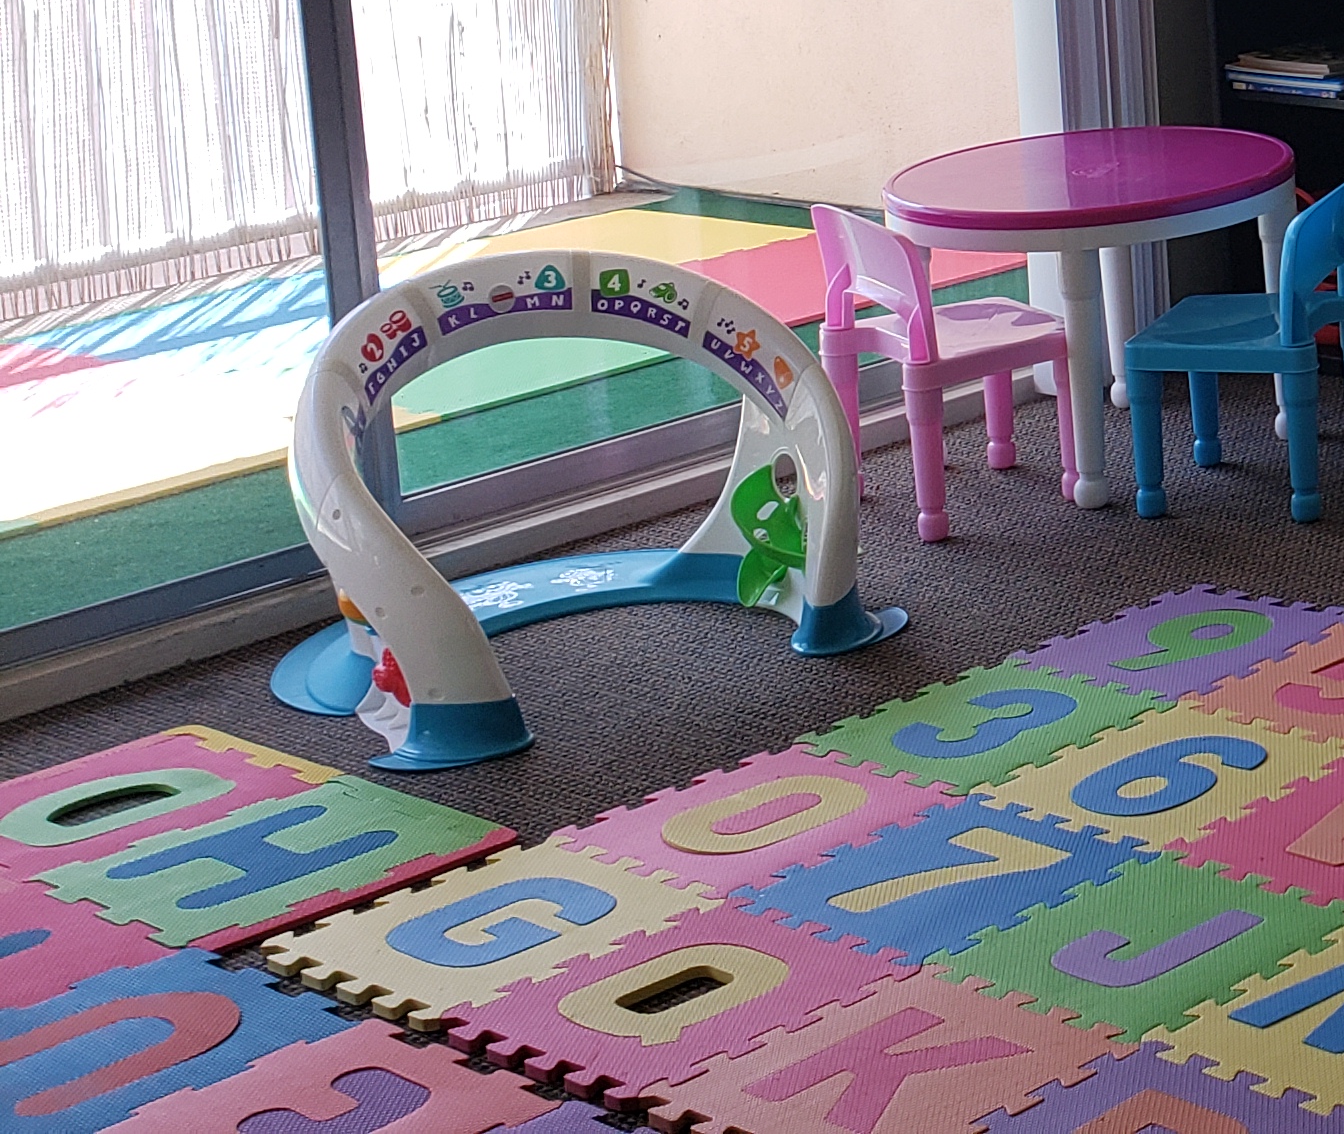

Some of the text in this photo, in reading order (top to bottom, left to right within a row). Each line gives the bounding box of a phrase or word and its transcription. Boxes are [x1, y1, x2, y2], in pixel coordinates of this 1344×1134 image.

[543, 270, 556, 288] 3
[607, 274, 621, 292] 4
[367, 342, 382, 360] 2
[1111, 608, 1274, 671] 9
[890, 688, 1077, 759] 3
[1071, 735, 1269, 816] 6
[105, 805, 397, 910] H
[826, 826, 1074, 913] 7
[386, 877, 616, 966] G
[1051, 908, 1263, 987] J
[742, 1007, 1034, 1134] K
